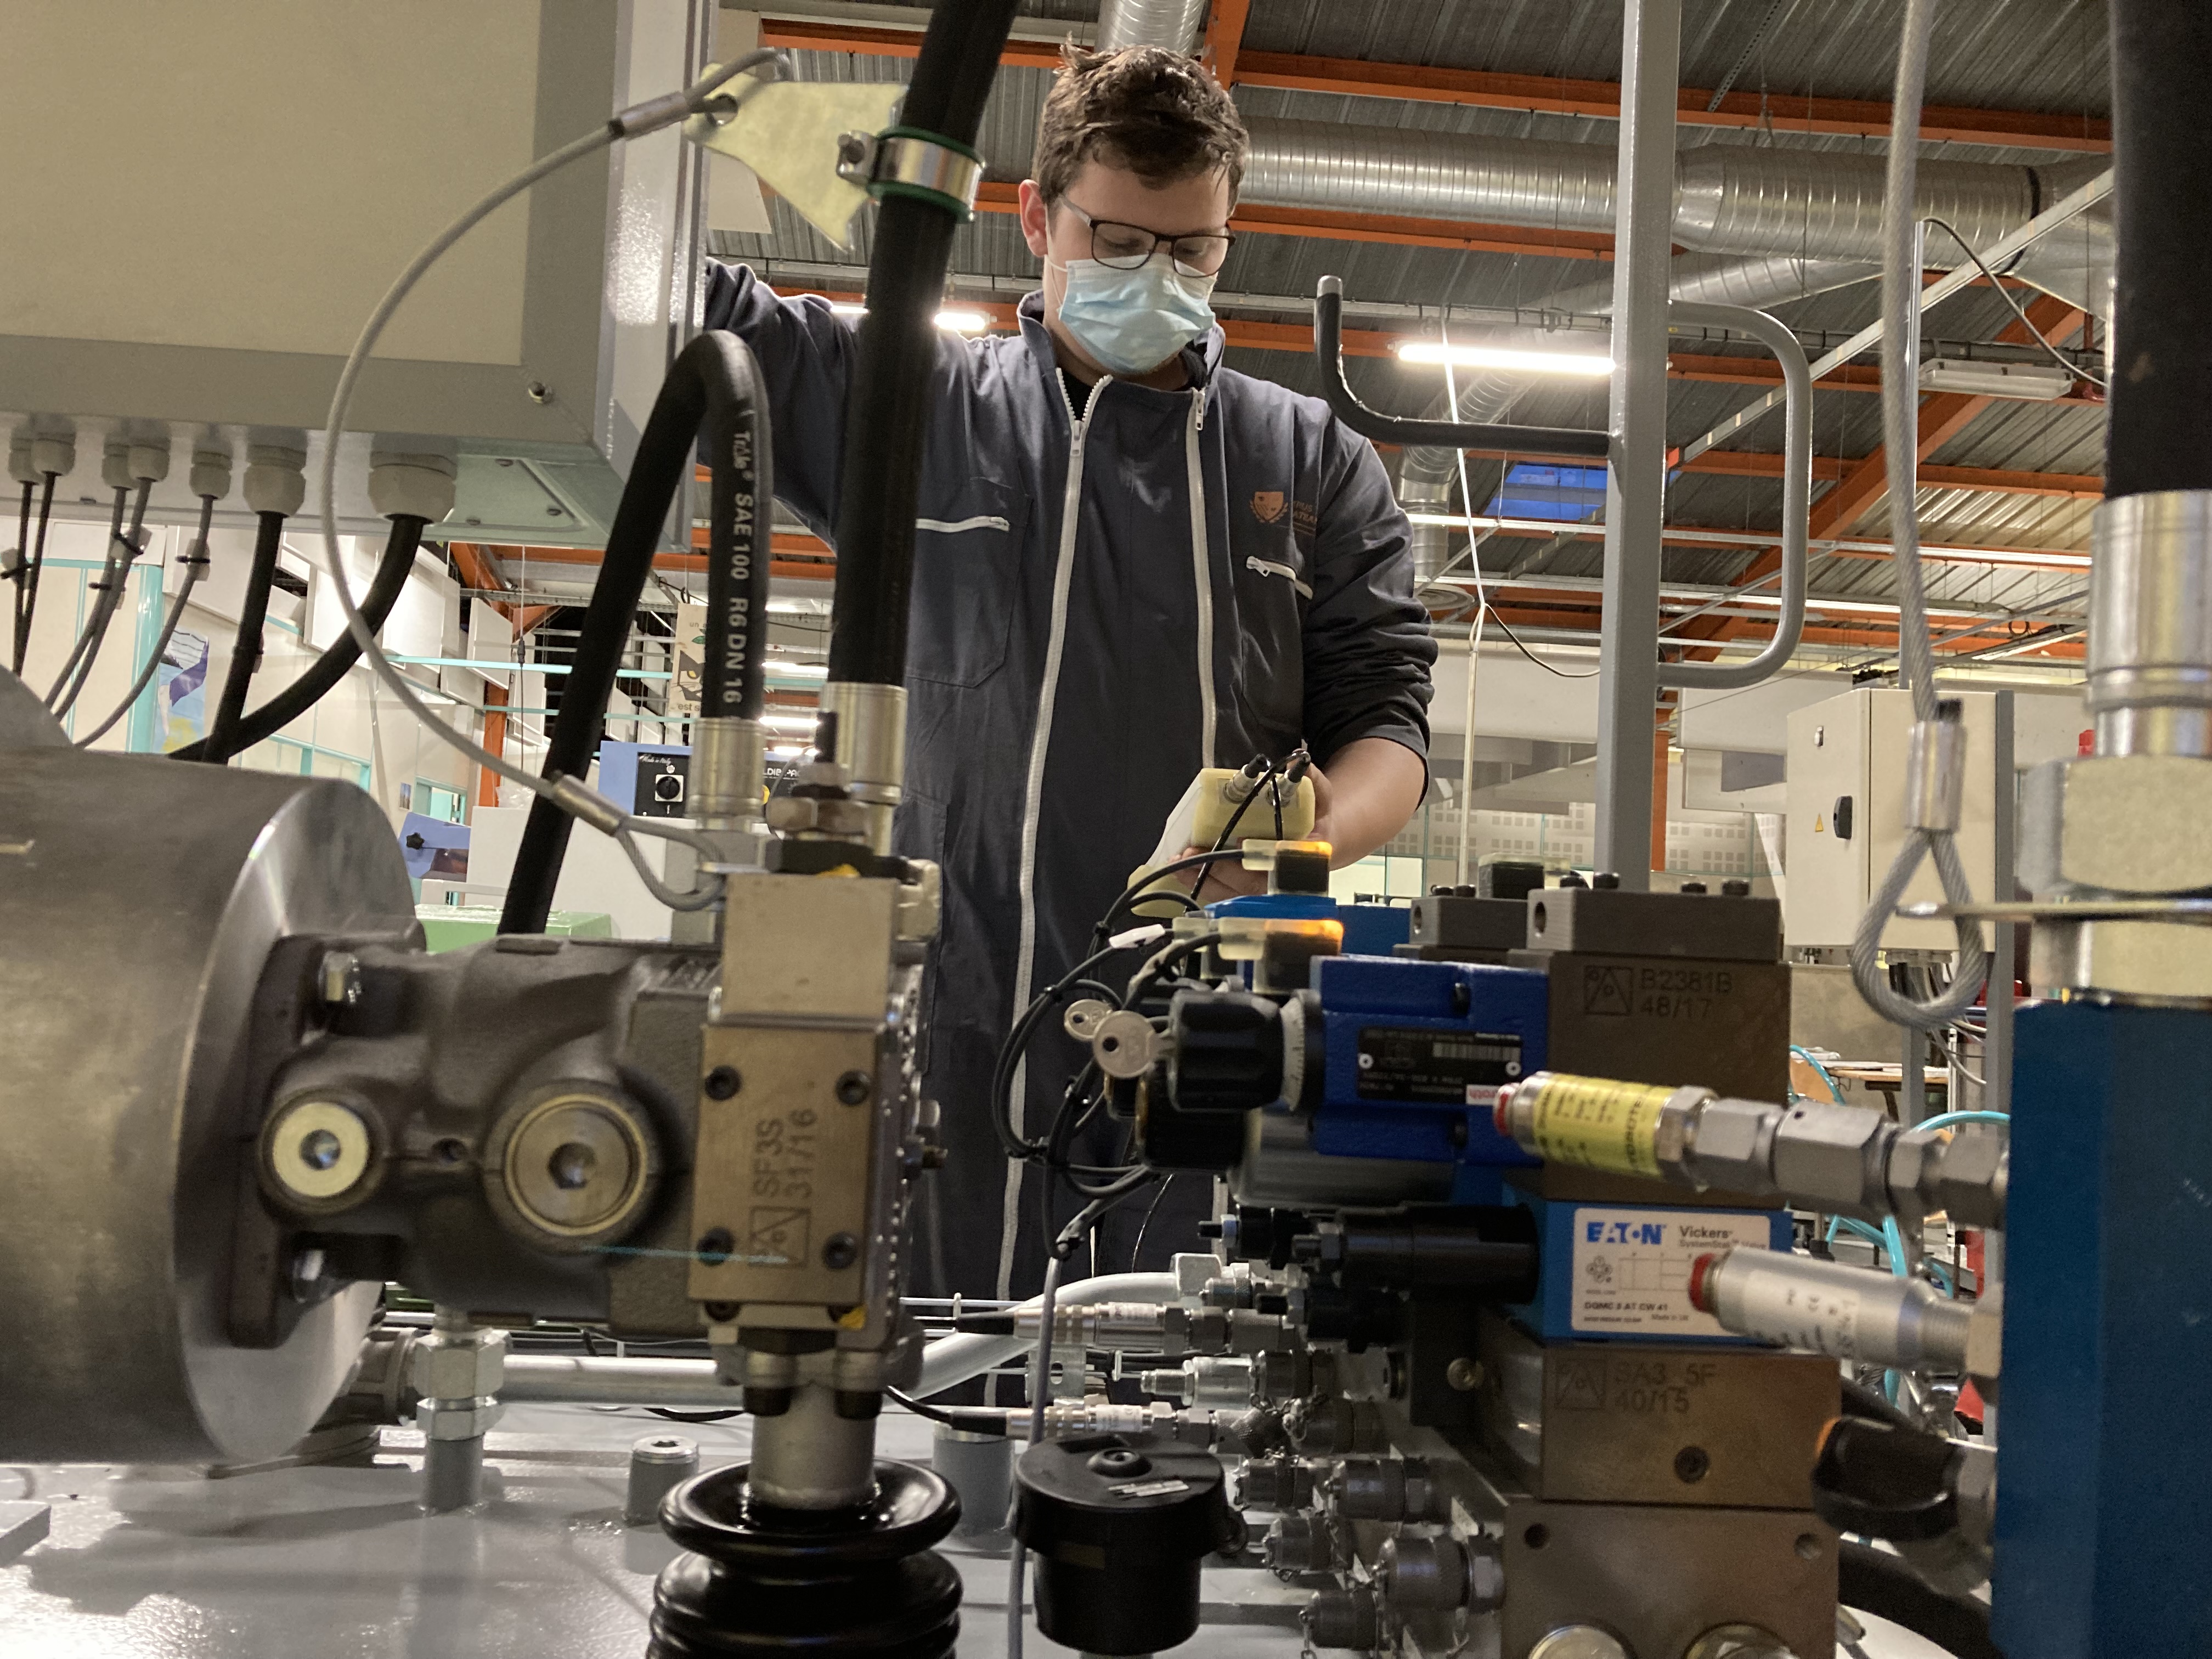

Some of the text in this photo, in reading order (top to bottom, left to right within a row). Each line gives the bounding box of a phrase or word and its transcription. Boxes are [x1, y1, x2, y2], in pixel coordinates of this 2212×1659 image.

[733, 493, 753, 537] SAE
[730, 544, 751, 580] 100
[728, 597, 749, 628] R6
[725, 634, 747, 670] DN
[723, 678, 743, 703] 16
[1640, 996, 1713, 1020] 48/17
[1587, 1222, 1662, 1245] EATON
[1679, 1225, 1729, 1239] Vickers
